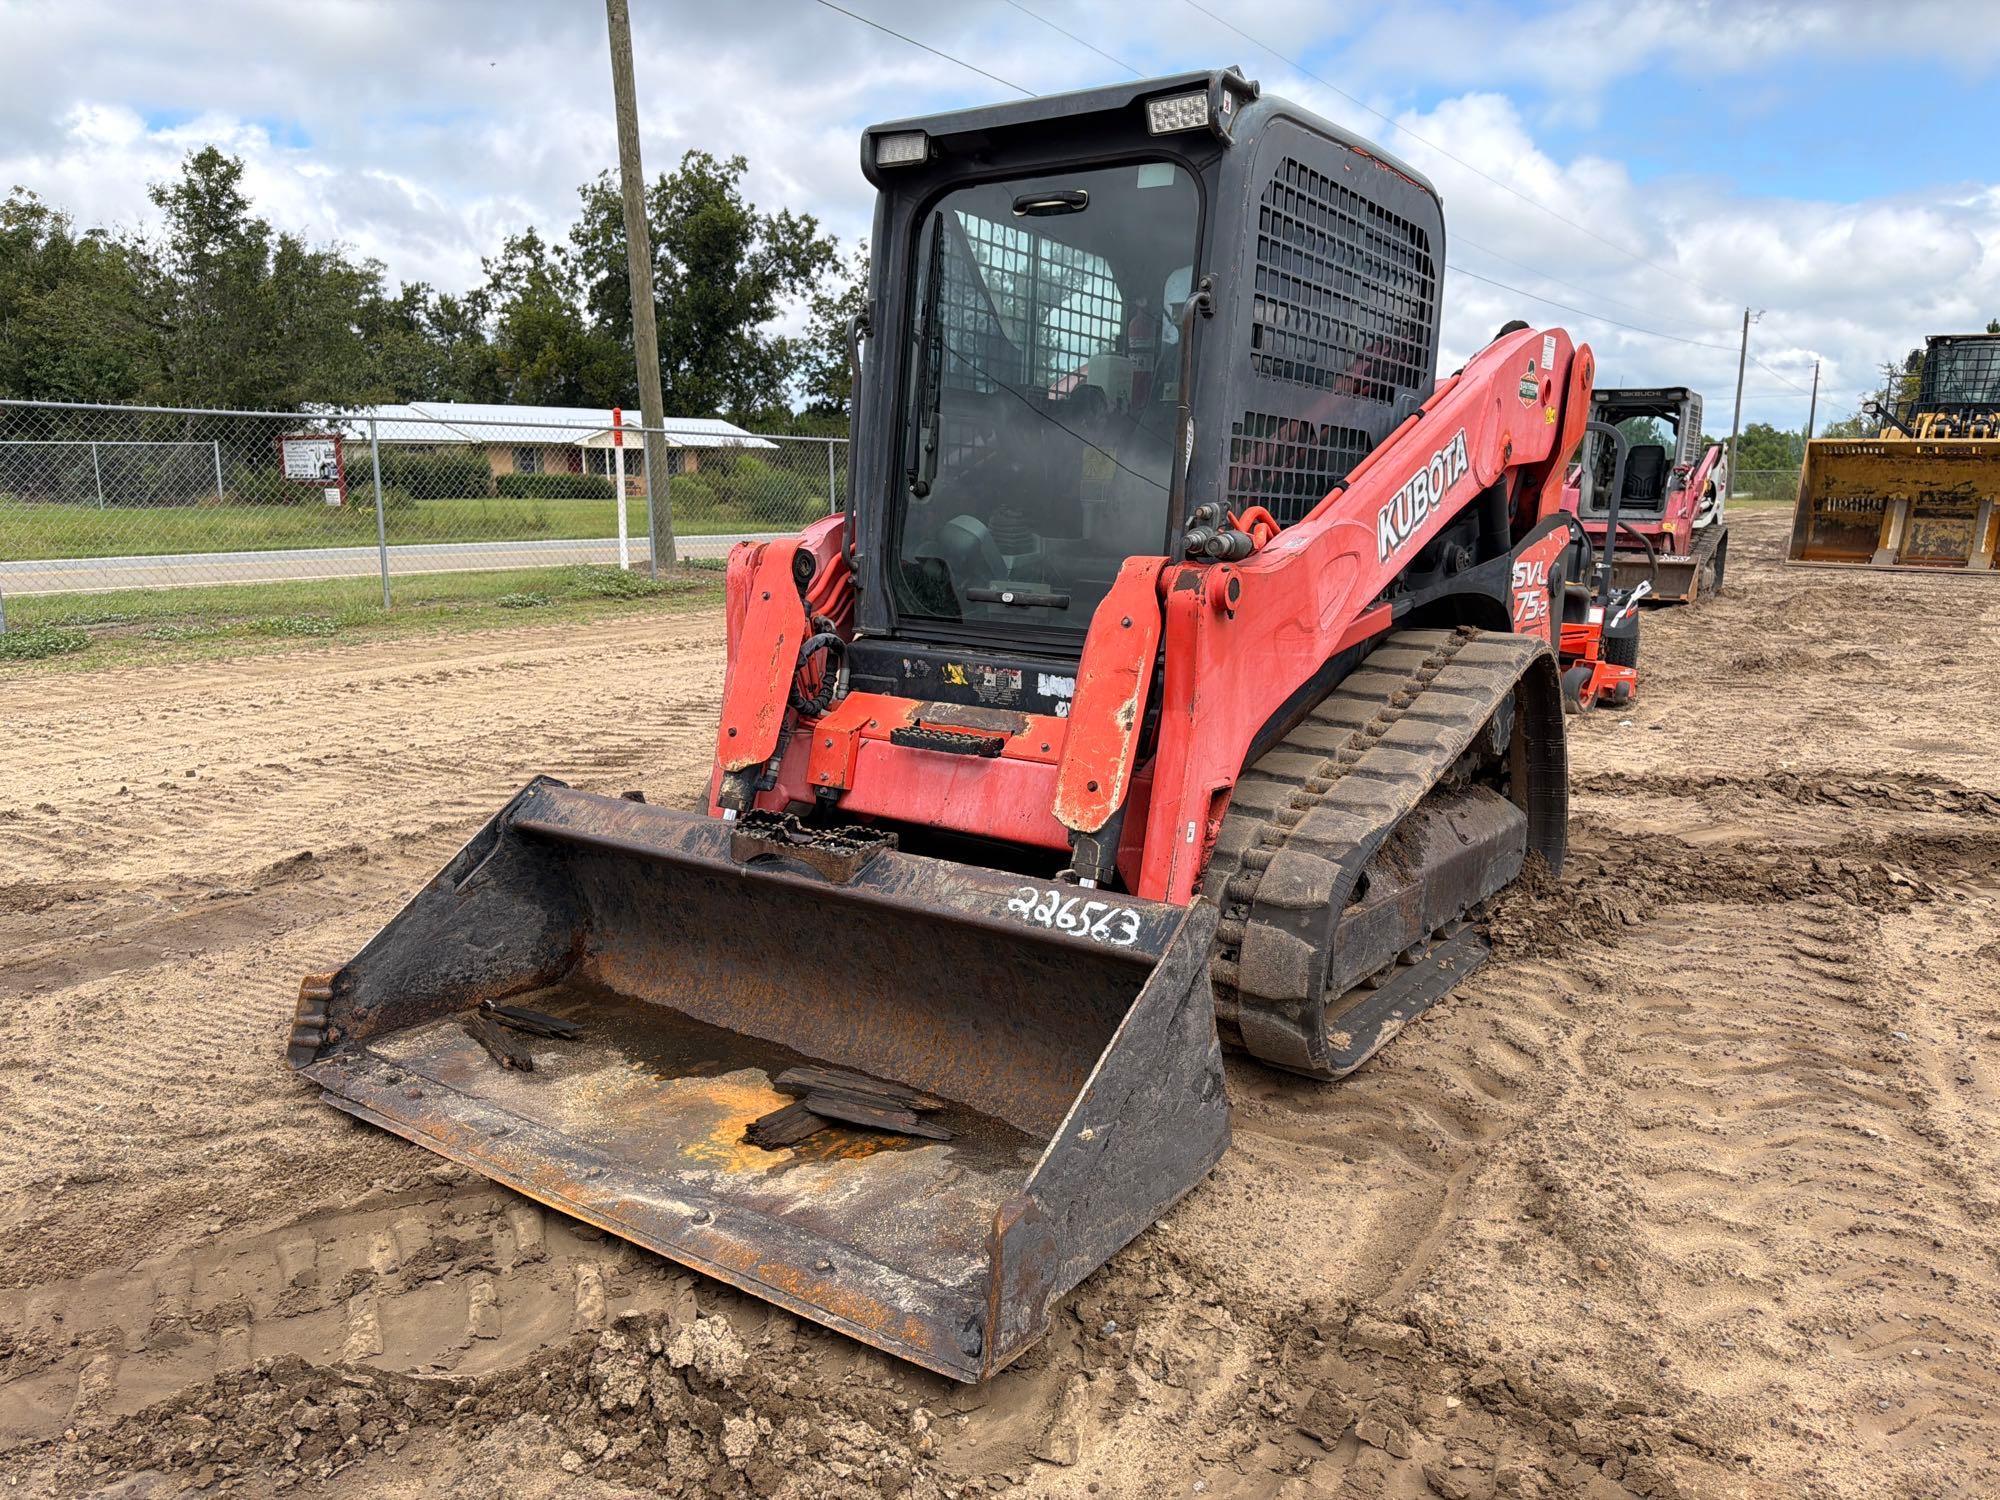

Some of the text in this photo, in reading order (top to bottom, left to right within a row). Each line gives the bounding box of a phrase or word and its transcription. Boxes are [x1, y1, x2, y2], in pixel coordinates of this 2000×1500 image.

[1378, 427, 1469, 562] KUBOTA
[1512, 561, 1548, 589] SVL
[1007, 886, 1141, 945] 226563
